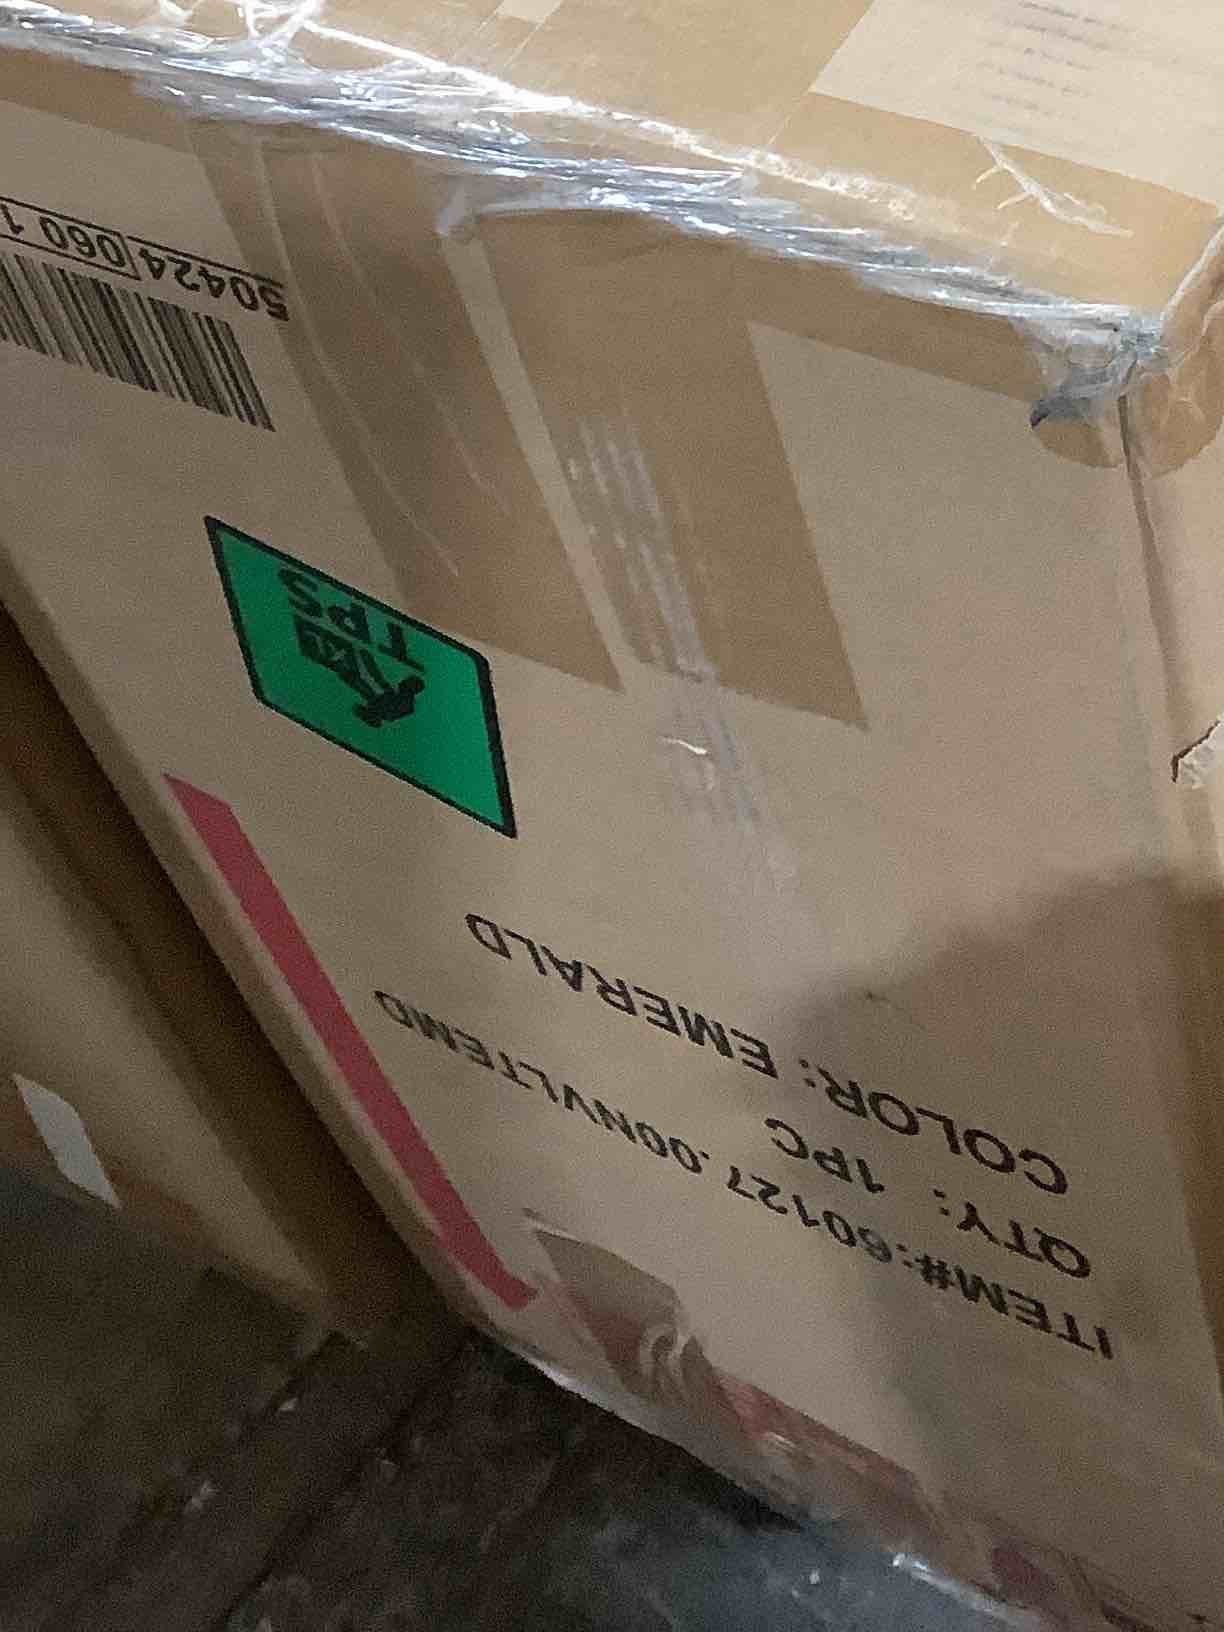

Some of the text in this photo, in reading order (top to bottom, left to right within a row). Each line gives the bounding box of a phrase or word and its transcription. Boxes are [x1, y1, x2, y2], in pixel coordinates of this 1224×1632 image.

[38, 216, 126, 269] 060
[137, 247, 290, 321] 50424
[276, 567, 425, 672] TPS
[463, 912, 1069, 1196] COLOR: EMERALD
[763, 1117, 1093, 1280] QTY: 1PC
